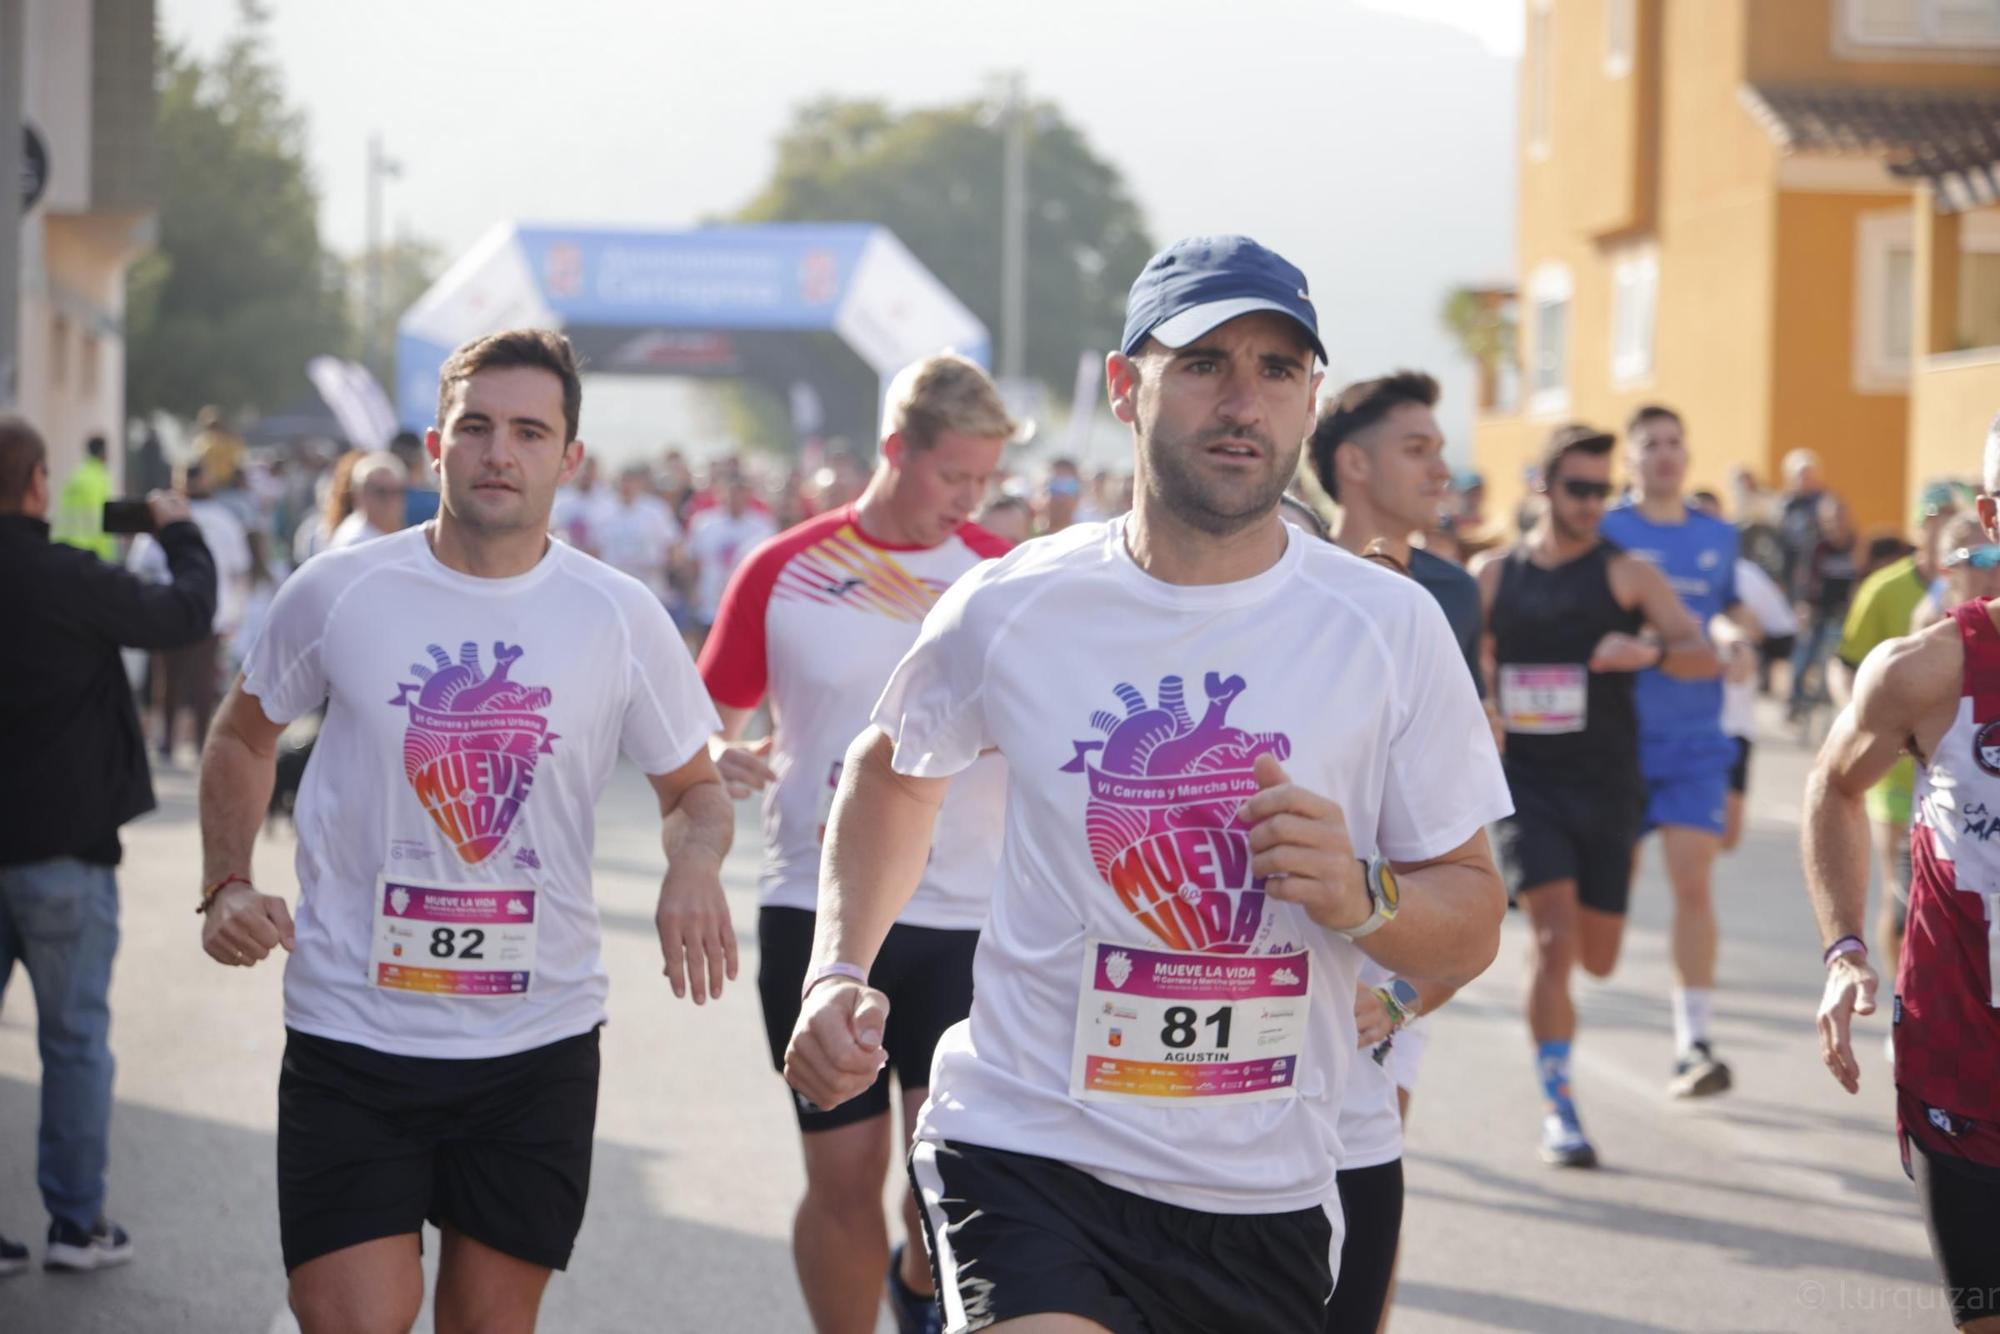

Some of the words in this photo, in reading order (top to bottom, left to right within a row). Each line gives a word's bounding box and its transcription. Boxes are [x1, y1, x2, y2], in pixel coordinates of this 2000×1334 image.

[471, 718, 506, 729] Marcha
[507, 717, 542, 730] Urbana
[415, 752, 534, 810] MUEVE
[1098, 781, 1110, 793] VI
[1113, 785, 1165, 799] Carrera
[1168, 787, 1175, 799] y
[1178, 782, 1228, 797] Marcha
[1231, 778, 1260, 791] Urb
[429, 796, 521, 845] VIDA
[1111, 830, 1266, 917] MUEV
[425, 894, 459, 907] MUEVE
[460, 896, 475, 907] LA
[475, 896, 497, 908] VIDA
[1135, 890, 1266, 951] VIDA
[430, 927, 485, 959] 82
[1154, 963, 1202, 977] MUEVE
[1205, 965, 1222, 978] LA
[1226, 966, 1256, 978] VIDA
[1161, 976, 1190, 985] Carrera
[1198, 977, 1227, 986] Marcha
[1160, 1005, 1233, 1049] 81
[1164, 1052, 1230, 1063] AGUSTIN
